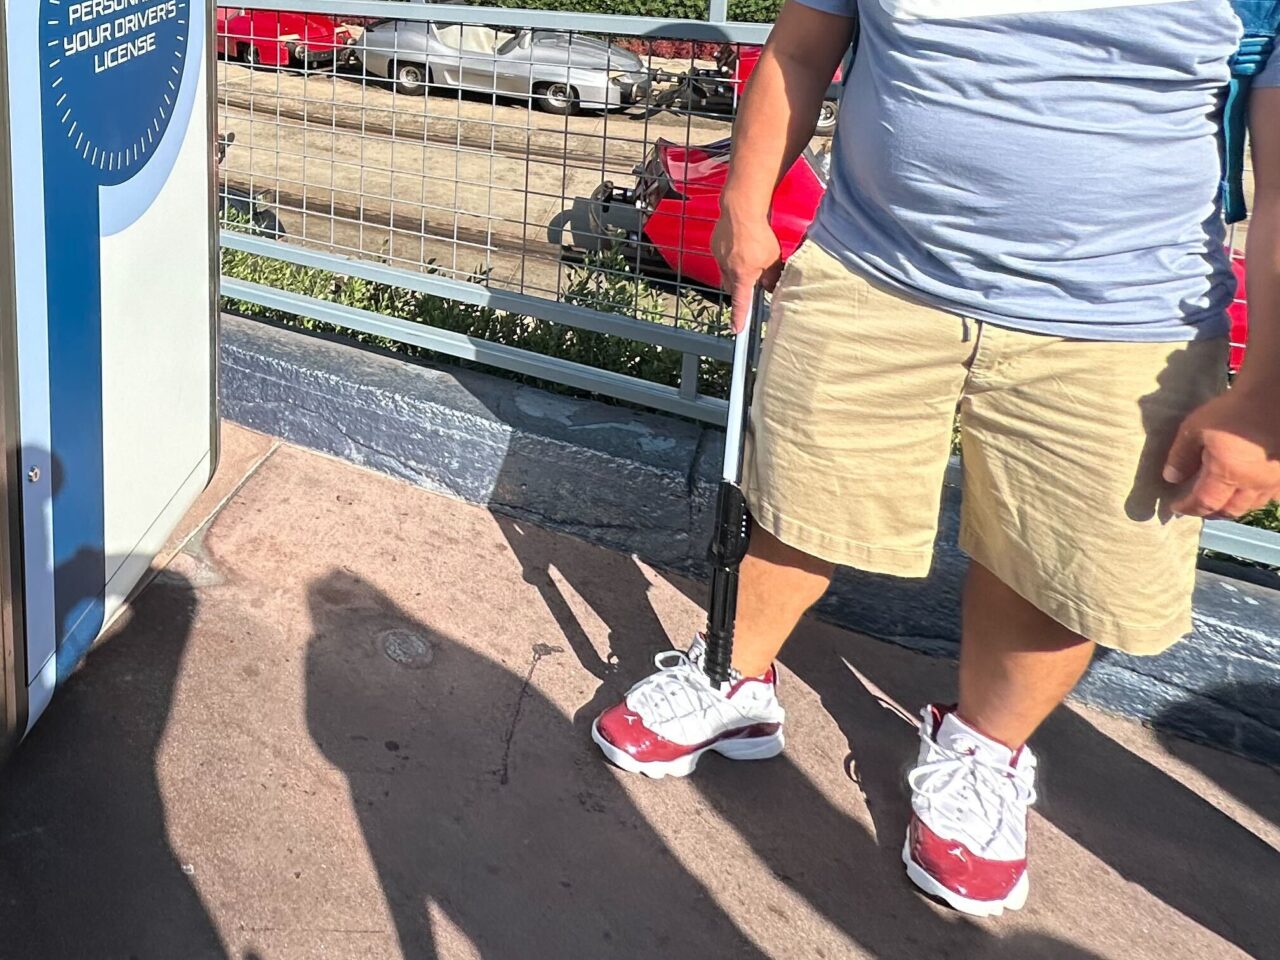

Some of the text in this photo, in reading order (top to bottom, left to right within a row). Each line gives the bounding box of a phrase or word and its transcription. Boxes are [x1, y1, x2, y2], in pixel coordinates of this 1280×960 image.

[63, 0, 177, 57] YOUR DRIVER'S
[93, 32, 157, 74] LICENSE
